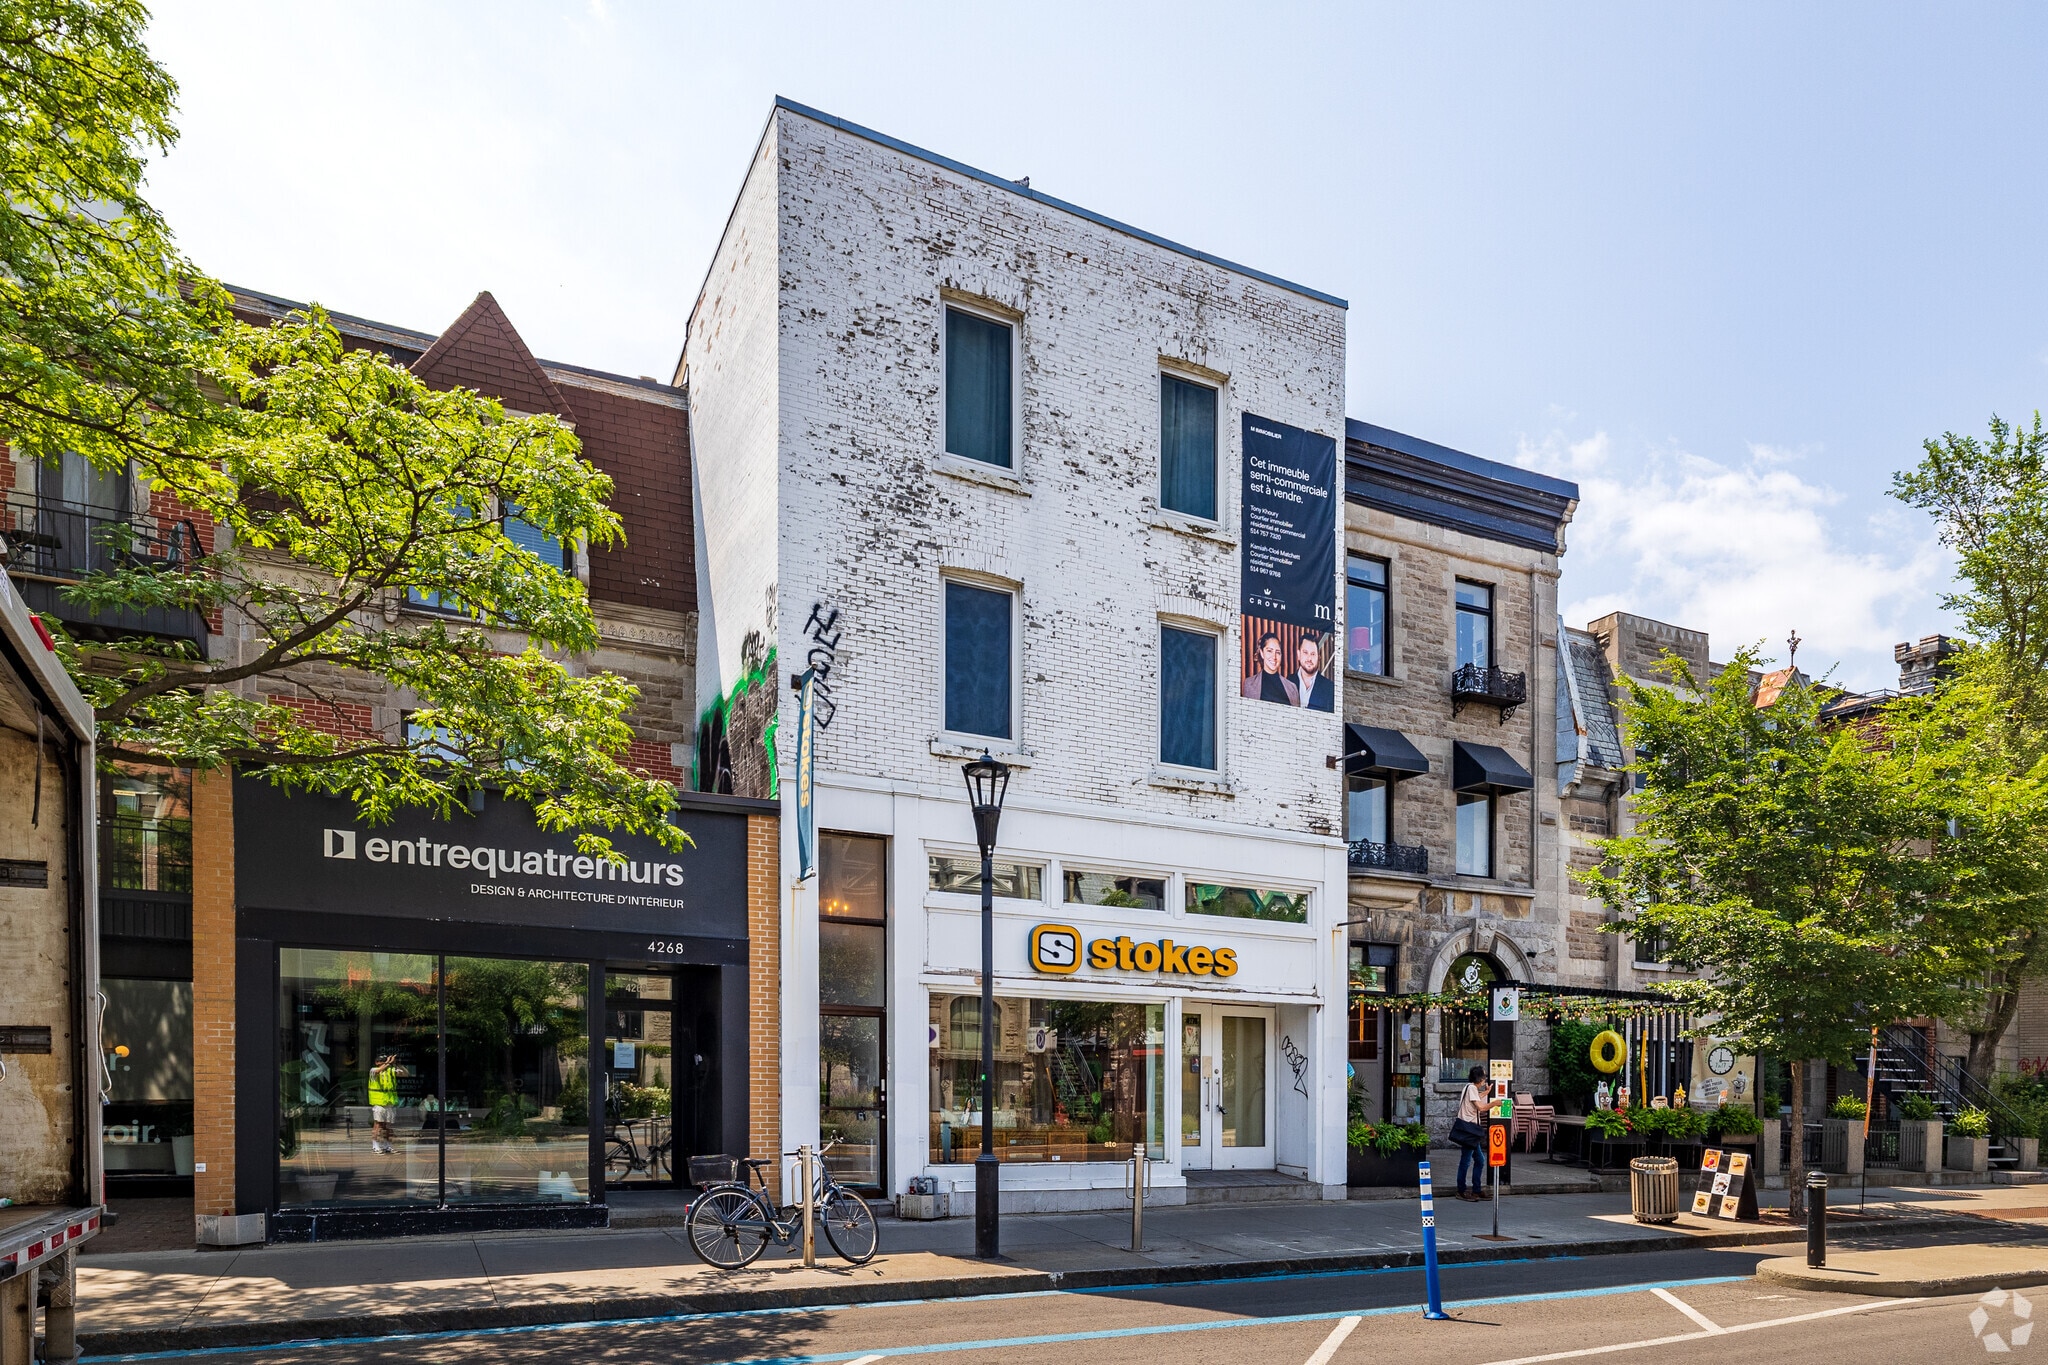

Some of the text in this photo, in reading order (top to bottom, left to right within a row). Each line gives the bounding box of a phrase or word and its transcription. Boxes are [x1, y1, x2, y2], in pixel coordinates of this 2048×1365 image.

[1250, 456, 1310, 481] Cet immeuble
[1250, 470, 1328, 498] semi-commerciale
[1250, 483, 1304, 504] est à vendre.
[1249, 597, 1286, 610] CROWN
[801, 712, 812, 808] stokes
[365, 837, 684, 886] entrequatremurs
[470, 884, 684, 908] DESIGN & ARCHITECTURE D'INTÉRIEUR
[647, 941, 684, 954] 4268
[1087, 936, 1238, 977] stokes
